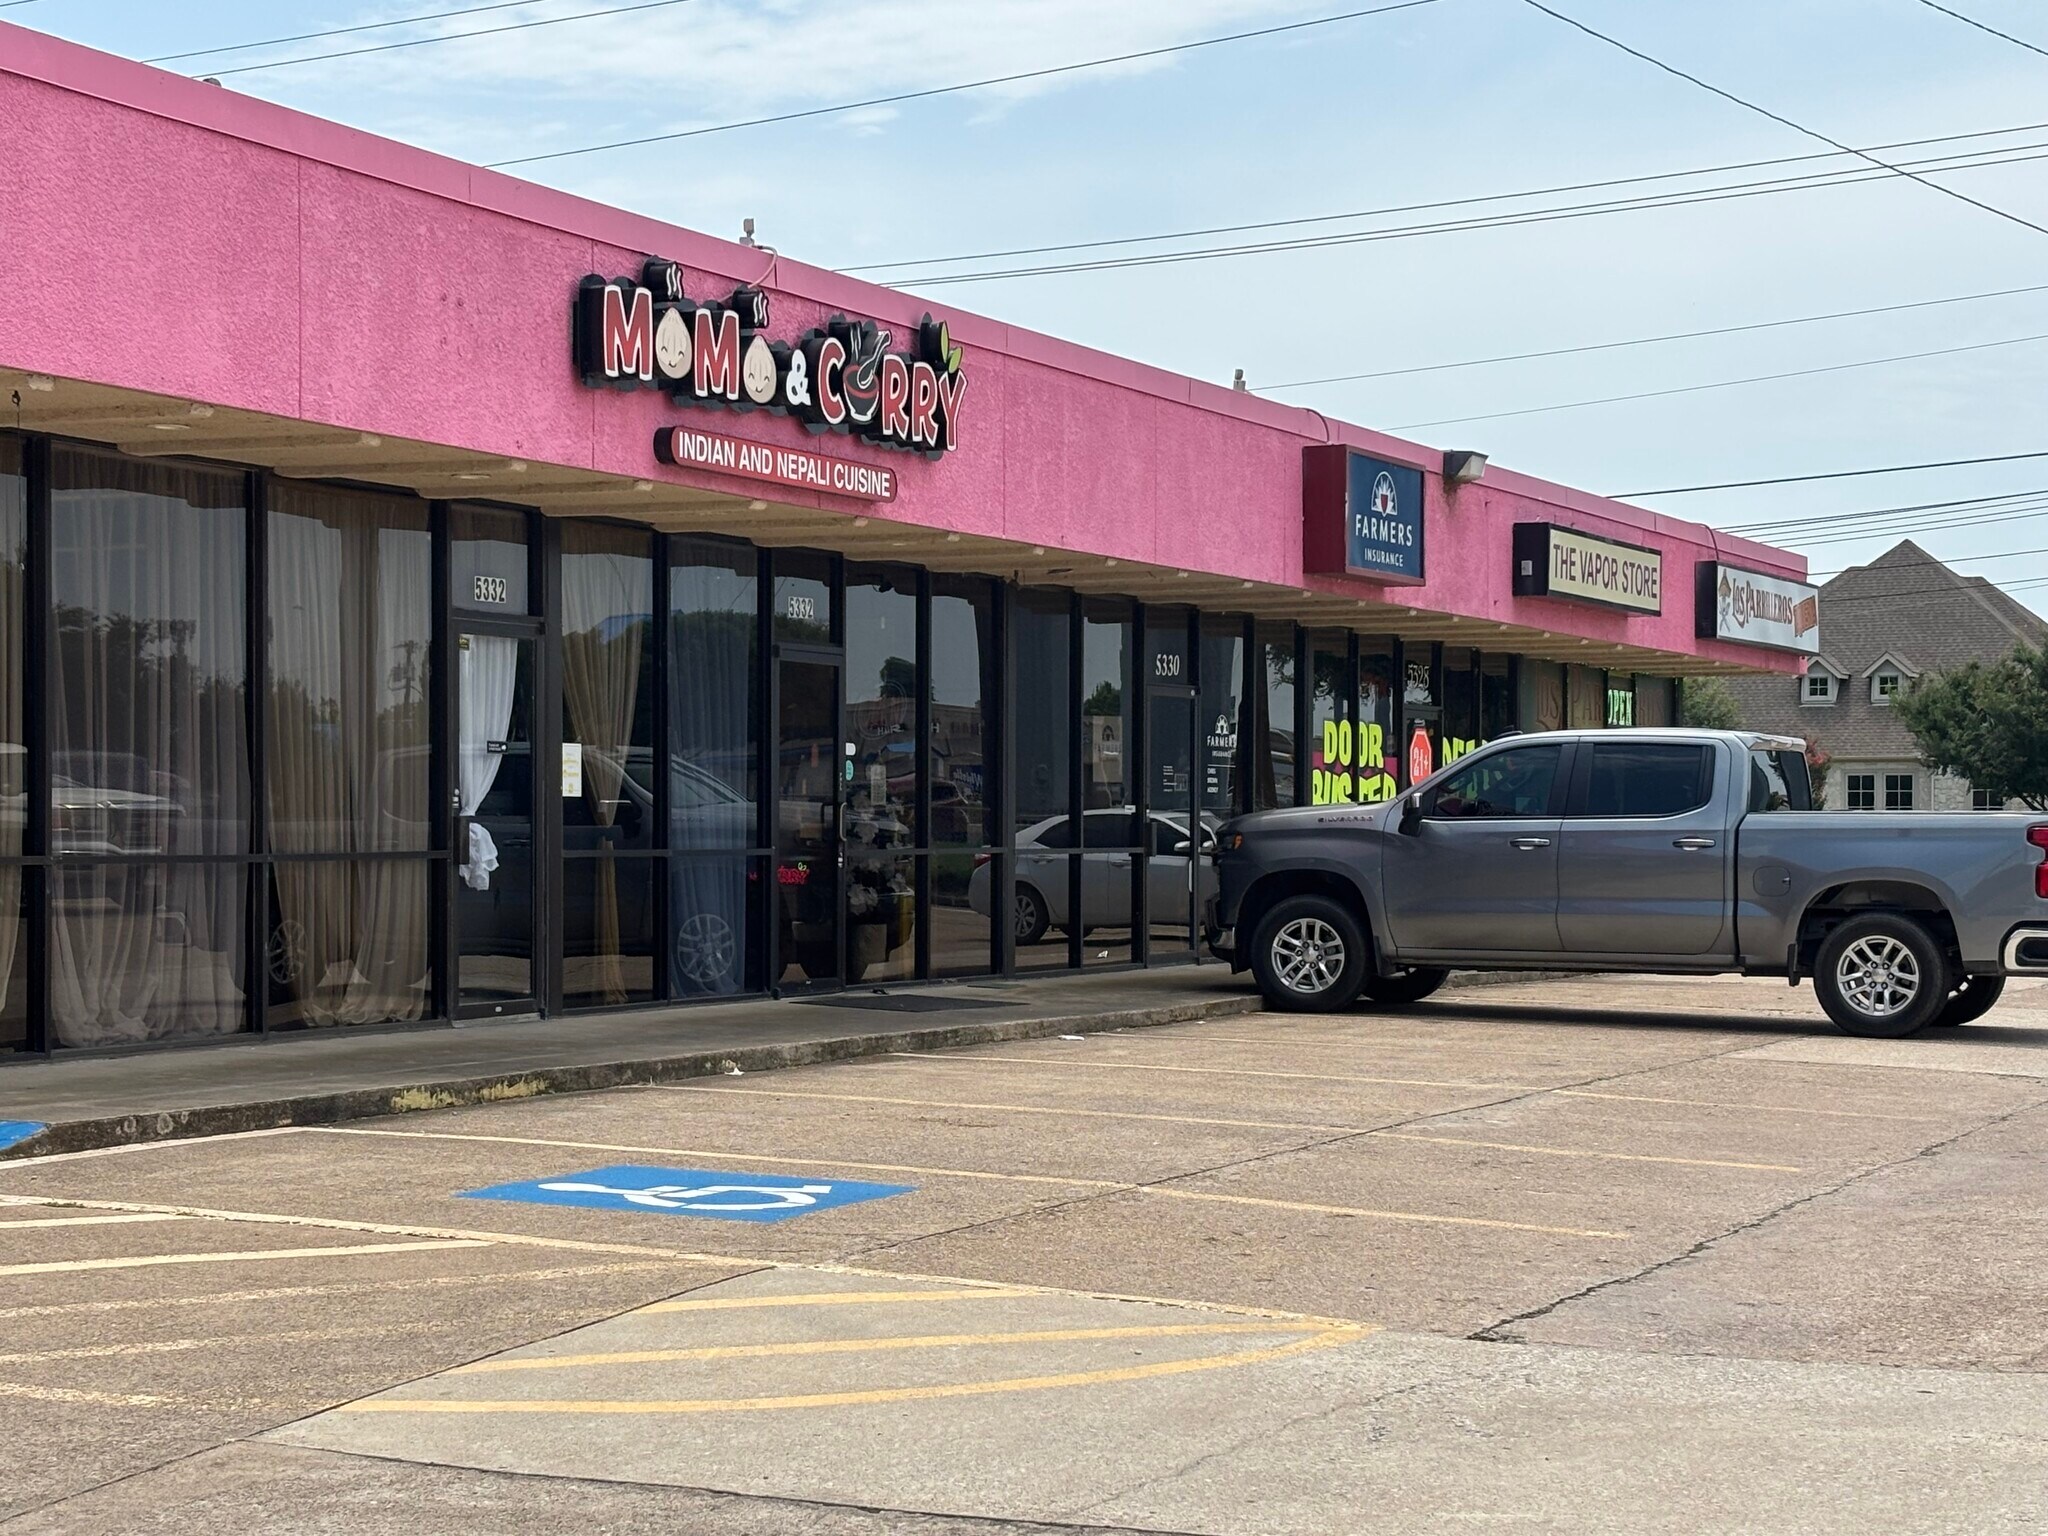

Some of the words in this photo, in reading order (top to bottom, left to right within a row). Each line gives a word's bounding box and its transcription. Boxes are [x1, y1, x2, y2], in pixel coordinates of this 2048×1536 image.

[786, 348, 811, 407] &
[678, 431, 735, 468] INDIAN
[738, 445, 774, 476] AND
[777, 453, 831, 486] NEPALI
[833, 467, 891, 498] CUISINE
[1355, 514, 1413, 547] FARMERS
[1364, 548, 1404, 567] INSURANCE
[1553, 543, 1577, 581] THE
[1580, 550, 1618, 591] VAPOR
[1622, 559, 1658, 599] STORE
[475, 577, 506, 602] 5332
[788, 597, 814, 619] 5332
[1155, 653, 1181, 677] 5330
[1407, 663, 1430, 689] 5328
[1607, 688, 1633, 726] OPEN
[1206, 735, 1237, 748] FARMERS
[1412, 746, 1429, 777] 21+
